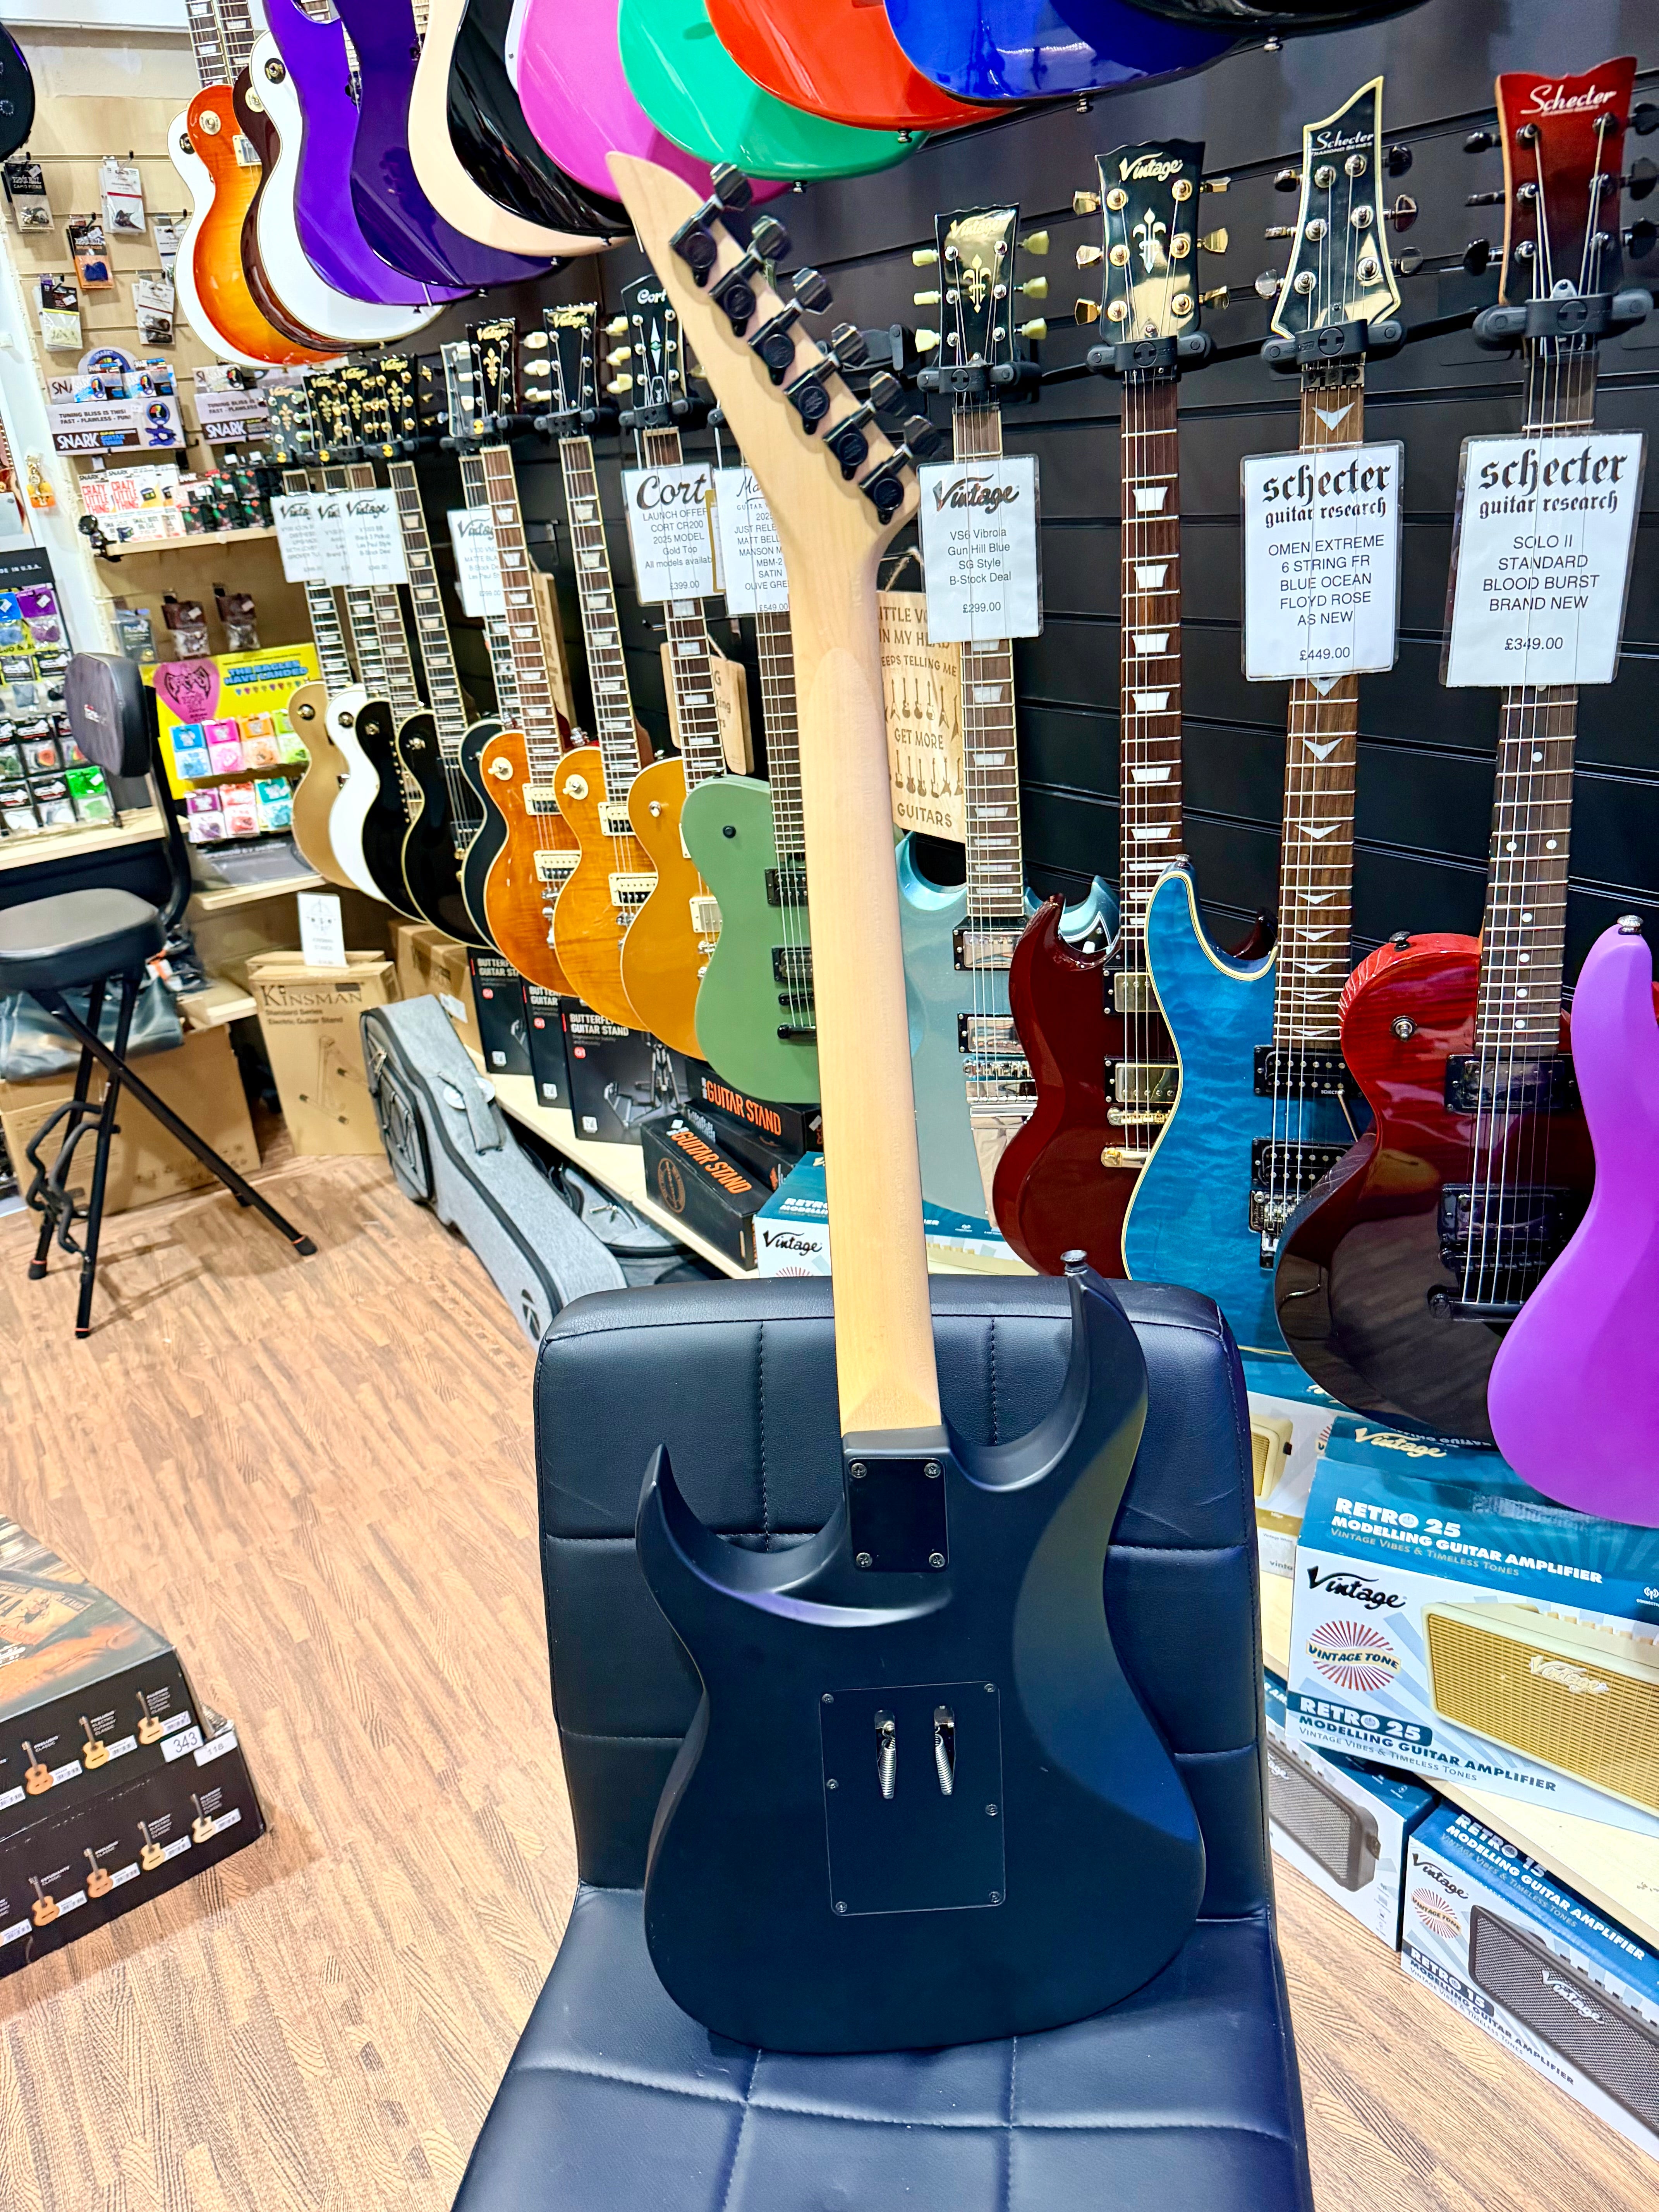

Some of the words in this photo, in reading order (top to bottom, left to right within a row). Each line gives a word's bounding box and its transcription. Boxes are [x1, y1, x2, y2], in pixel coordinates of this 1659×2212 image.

[1520, 84, 1617, 115] Schecter
[1312, 130, 1374, 151] Schecter
[1346, 142, 1372, 151] SERIES
[1119, 152, 1182, 182] Vintage
[950, 210, 1001, 239] Vintage
[637, 288, 666, 304] Cort
[553, 312, 587, 329] Vintage
[206, 421, 247, 438] SNARK
[57, 433, 100, 449] SNARK
[1478, 445, 1628, 496] schecter
[81, 484, 106, 495] CRAZY
[111, 480, 136, 491] CRAZY
[636, 473, 707, 510] Cort
[1262, 458, 1391, 507] schecter
[84, 494, 110, 505] LITTLE
[113, 489, 139, 501] LITTLE
[933, 473, 1020, 514] Vintage
[346, 497, 390, 519] Vintage
[1265, 506, 1314, 529] guitar
[1320, 496, 1387, 520] research
[1479, 494, 1536, 520] guitar
[1542, 489, 1618, 514] research
[642, 510, 677, 522] LAUNCH
[651, 522, 674, 533] CORT
[677, 520, 704, 531] CR200
[734, 525, 753, 534] JUST
[973, 528, 1007, 539] Vibrola
[653, 534, 673, 544] 2025
[674, 532, 705, 543] MODEL
[737, 536, 758, 545] MATT
[1268, 541, 1310, 556] OMEN
[1315, 534, 1385, 552] EXTREME
[1513, 534, 1559, 550] SOLO
[1563, 534, 1573, 547] II
[663, 546, 680, 556] Gold
[683, 545, 697, 555] Top
[739, 548, 774, 556] MANSON
[948, 546, 968, 556] Gun
[971, 544, 986, 554] Hill
[989, 542, 1010, 552] Blue
[645, 559, 655, 569] All
[656, 557, 684, 568] models
[685, 555, 712, 566] availab
[958, 560, 974, 570] SG
[977, 558, 1001, 569] Style
[1282, 562, 1289, 573] 6
[1293, 556, 1347, 572] STRING
[1352, 555, 1370, 567] FR
[1498, 554, 1588, 571] STANDARD
[758, 569, 782, 578] SATIN
[950, 574, 986, 585] B-Stock
[990, 571, 1012, 582] Deal
[1280, 577, 1317, 591] BLUE
[1321, 572, 1372, 588] OCEAN
[1483, 576, 1539, 592] BLOOD
[1544, 574, 1600, 590] BURST
[670, 580, 700, 591] £399.00
[745, 582, 768, 590] OLIVE
[759, 603, 788, 612] £549.00
[962, 601, 1001, 613] £299.00
[1280, 595, 1327, 610] FLOYD
[1331, 591, 1371, 606] ROSE
[1489, 597, 1546, 611] BRAND
[1550, 595, 1589, 610] NEW
[1297, 613, 1316, 626] AS
[1320, 611, 1353, 625] NEW
[879, 629, 890, 643] IN
[894, 630, 912, 645] MY
[1504, 637, 1564, 651] £349.00
[1299, 646, 1351, 661] £449.00
[228, 666, 252, 676] THE
[254, 659, 300, 674] EAGLES
[903, 655, 940, 671] TELLING
[943, 663, 957, 677] ME
[223, 673, 258, 686] HAVE
[258, 667, 309, 680] LANDED
[895, 727, 912, 744] GET
[915, 731, 944, 750] MORE
[897, 802, 952, 828] GUITARS
[479, 968, 506, 976] GUITAR
[531, 996, 558, 1006] GUITAR
[570, 1024, 600, 1035] GUITAR
[601, 1026, 629, 1037] STAND
[706, 1080, 745, 1118] GUITAR
[745, 1099, 781, 1136] STAND
[671, 1131, 720, 1165] GUITAR
[705, 1161, 752, 1194] STAND
[763, 1230, 823, 1256] Vintage
[1355, 1427, 1448, 1458] Vintage
[1334, 1497, 1419, 1528] RETRO
[1424, 1518, 1462, 1538] 25
[1331, 1516, 1432, 1546] MODELLING
[1436, 1539, 1502, 1561] GUITAR
[1505, 1553, 1603, 1583] AMPLIFIER
[1331, 1527, 1376, 1546] VINTAGE
[1379, 1539, 1410, 1553] VIBES
[1413, 1547, 1423, 1556] &
[1426, 1550, 1479, 1568] TIMELESS
[1483, 1562, 1519, 1577] TONES
[1307, 1565, 1408, 1610] Vintage
[1309, 1643, 1362, 1662] VINTAGE
[1364, 1653, 1400, 1669] TONE
[1529, 1655, 1609, 1693] Vintage
[1300, 1697, 1380, 1730] RETRO
[1385, 1723, 1421, 1741] 25
[173, 1732, 198, 1753] 343
[207, 1743, 224, 1755] 118
[1299, 1716, 1394, 1747] MODELLING
[1398, 1743, 1460, 1766] GUITAR
[1464, 1759, 1556, 1792] AMPLIFIER
[1299, 1727, 1342, 1745] VINTAGE
[1345, 1739, 1374, 1754] VIBES
[1377, 1748, 1386, 1756] &
[1389, 1751, 1441, 1771] TIMELESS
[1443, 1765, 1477, 1781] TONES
[1454, 1814, 1518, 1859] RETRO
[1522, 1856, 1547, 1879] 15
[1412, 1853, 1469, 1899] Vintage
[1441, 1833, 1474, 1859] VINTAGE
[1475, 1854, 1499, 1875] VIBES
[1499, 1872, 1508, 1881] &
[1509, 1879, 1548, 1908] TIMELESS
[1549, 1905, 1577, 1928] TONES
[1446, 1825, 1520, 1877] MODELLING
[1521, 1875, 1571, 1911] GUITAR
[1570, 1908, 1645, 1961] AMPLIFIER
[1412, 1897, 1440, 1918] VINTAGE
[1442, 1915, 1461, 1931] TONE
[1410, 1947, 1461, 1990] RETRO
[1466, 1988, 1486, 2009] 15
[1542, 1970, 1605, 2025] Vintage
[1410, 1967, 1438, 1991] VINTAGE
[1439, 1989, 1458, 2006] VIBES
[1466, 2010, 1499, 2035] TIMELESS
[1500, 2033, 1523, 2055] TONES
[1410, 1960, 1470, 2006] MODELLING
[1472, 2007, 1512, 2039] GUITAR
[1515, 2038, 1574, 2085] AMPLIFIER
